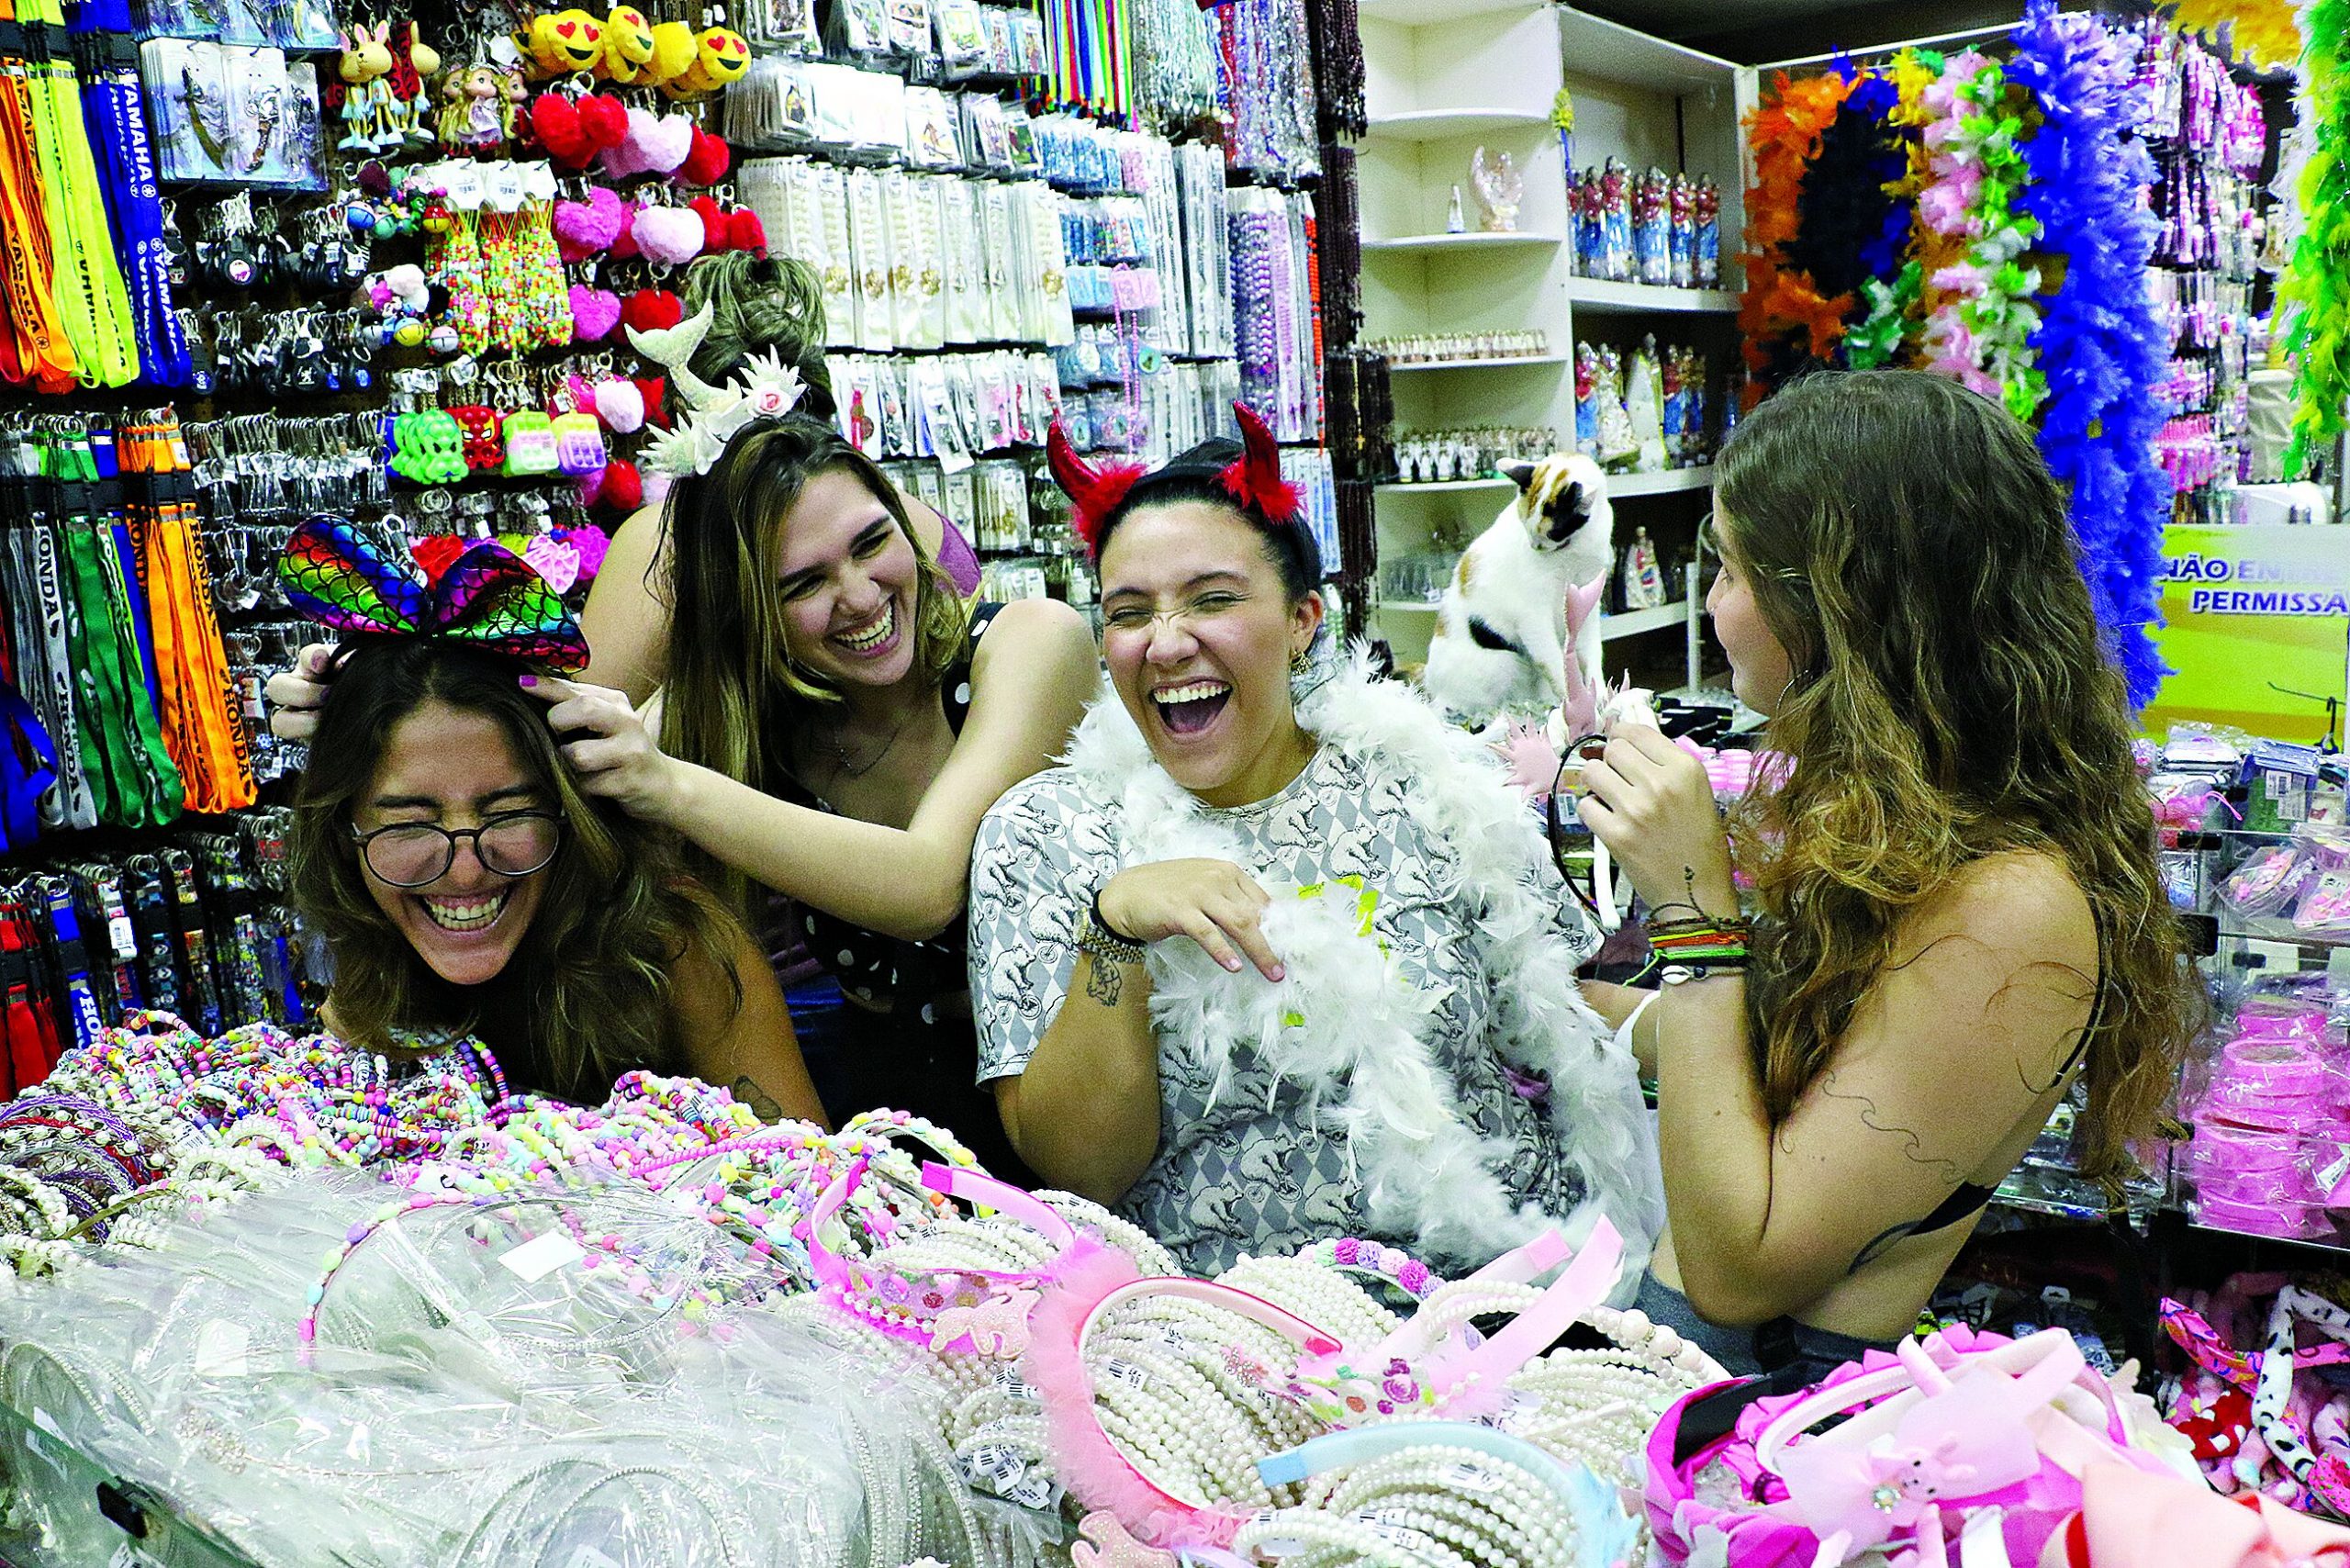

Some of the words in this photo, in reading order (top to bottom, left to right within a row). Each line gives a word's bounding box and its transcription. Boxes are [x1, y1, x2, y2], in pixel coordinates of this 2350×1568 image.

[120, 73, 153, 182] YAMAHA
[190, 522, 217, 619] HONDA
[59, 691, 80, 793] HONDA
[222, 689, 251, 779] HONDA
